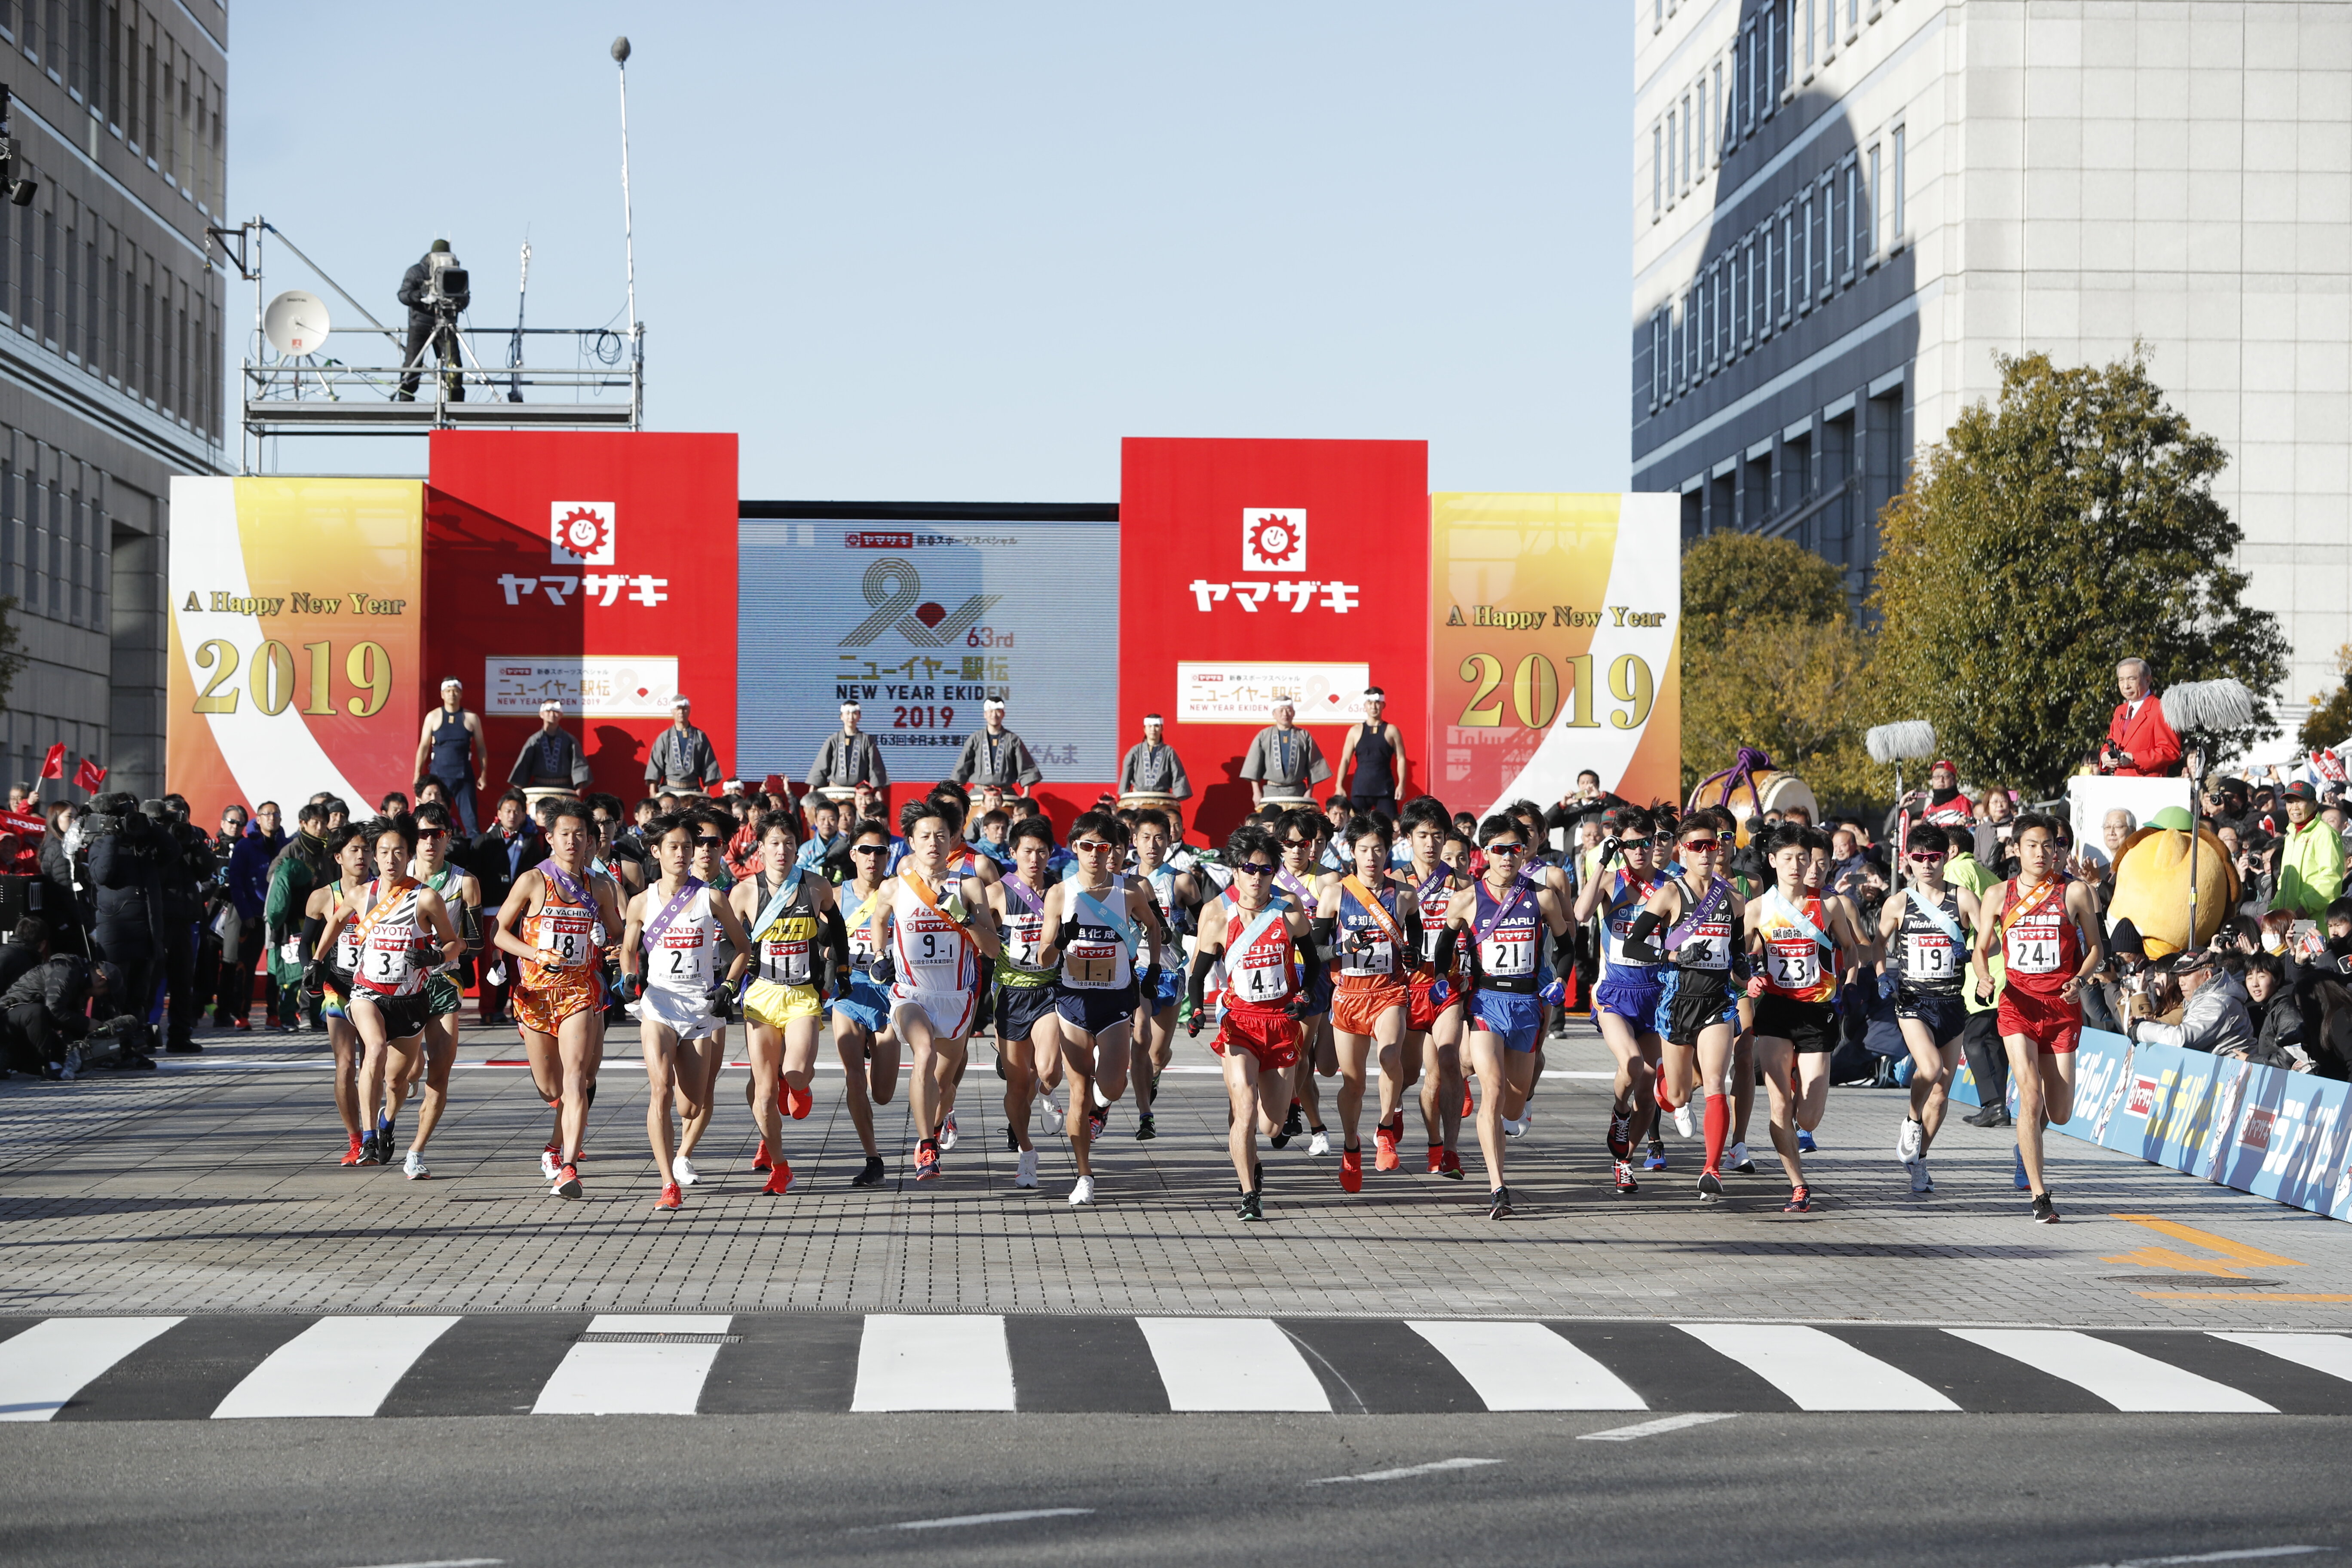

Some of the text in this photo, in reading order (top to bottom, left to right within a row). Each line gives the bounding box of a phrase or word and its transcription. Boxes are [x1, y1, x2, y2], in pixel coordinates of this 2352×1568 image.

[864, 535, 1017, 546] ヤマザキ 新春スポーツスペシャル
[497, 574, 668, 607] ヤマザキ
[1189, 579, 1359, 613] ヤマザキ
[183, 591, 406, 616] A Happy New Year
[1446, 605, 1666, 630] A Happy New Year
[967, 627, 1014, 648] 63rd
[192, 639, 392, 718] 2019
[836, 655, 1009, 681] ニューイヤー駅伝
[498, 680, 610, 696] ニューイヤー駅伝
[836, 684, 1010, 701] NEW YEAR EKIDEN
[1190, 685, 1302, 702] ニューイヤー駅伝
[1457, 652, 1654, 730] 2019
[894, 706, 954, 729] 2019
[6, 817, 46, 831] HON
[556, 909, 592, 918] YACHIYO
[1424, 903, 1446, 911] NISSIN
[556, 924, 586, 932] ヤマザキ
[771, 925, 803, 934] 九電工
[1482, 917, 1535, 927] SUBARU
[2015, 915, 2061, 925] ヨタ紡織
[373, 926, 412, 937] OYOTA
[1495, 932, 1532, 940] ヤマザキ
[376, 940, 410, 949] ヤマザキ
[553, 934, 584, 959] 18-1
[771, 944, 806, 953] ヤマザキ
[923, 934, 952, 958] 9-1
[1780, 947, 1813, 955] ヤマザキ
[2018, 943, 2055, 965] 24-1
[379, 952, 408, 976] 3-1
[671, 950, 699, 974] 2-1
[1244, 956, 1279, 966] ヤマザキ
[1354, 945, 1388, 968] 12-1
[1496, 944, 1531, 968] 21-1
[1920, 949, 1953, 971] 19-1
[771, 957, 805, 978] 11-1
[1085, 960, 1111, 981] 1-1
[1778, 959, 1815, 981] 23-1
[1252, 970, 1280, 993] 4-1
[2135, 1086, 2153, 1112] ヤマザキ
[2145, 1069, 2223, 1150] ランチパック
[2250, 1116, 2271, 1141] ヤマザキ
